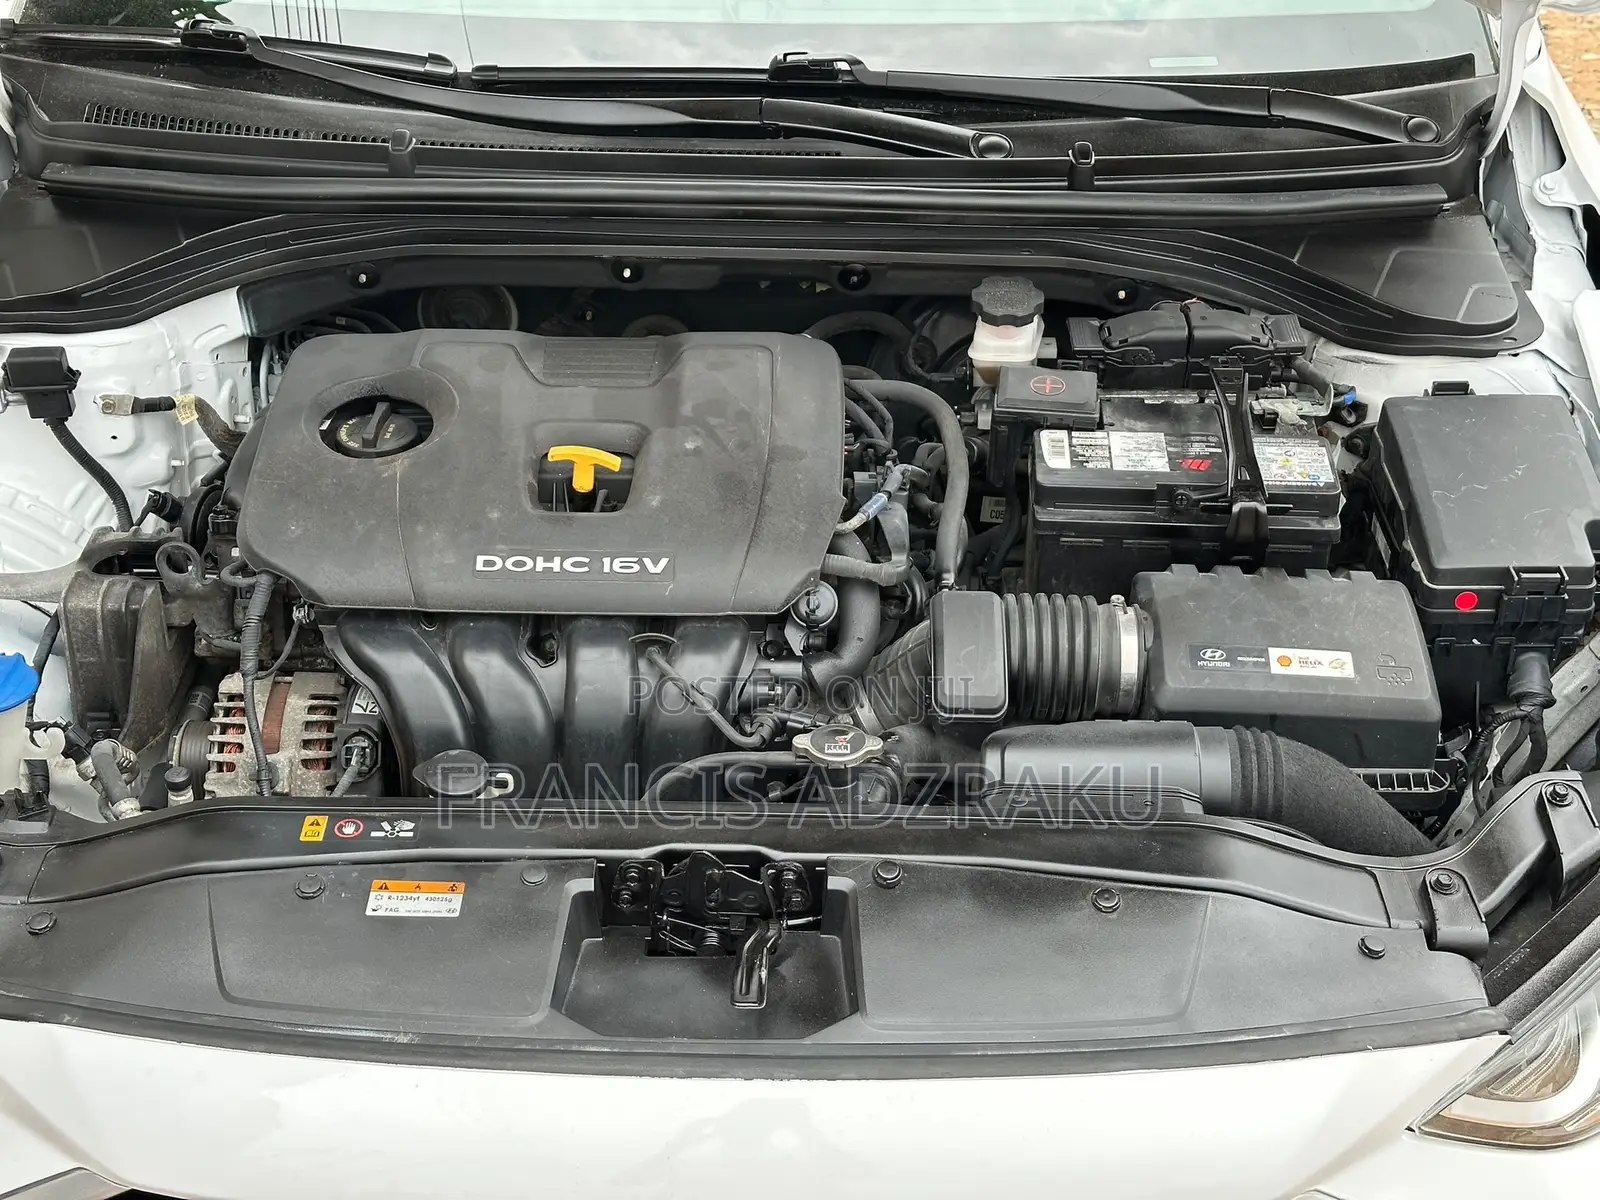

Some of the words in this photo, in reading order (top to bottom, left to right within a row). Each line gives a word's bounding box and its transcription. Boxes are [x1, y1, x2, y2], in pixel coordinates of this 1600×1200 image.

[475, 555, 591, 573] DOHC
[602, 557, 670, 574] 16V
[1298, 659, 1324, 667] HELIX
[387, 895, 421, 903] R-1234yf
